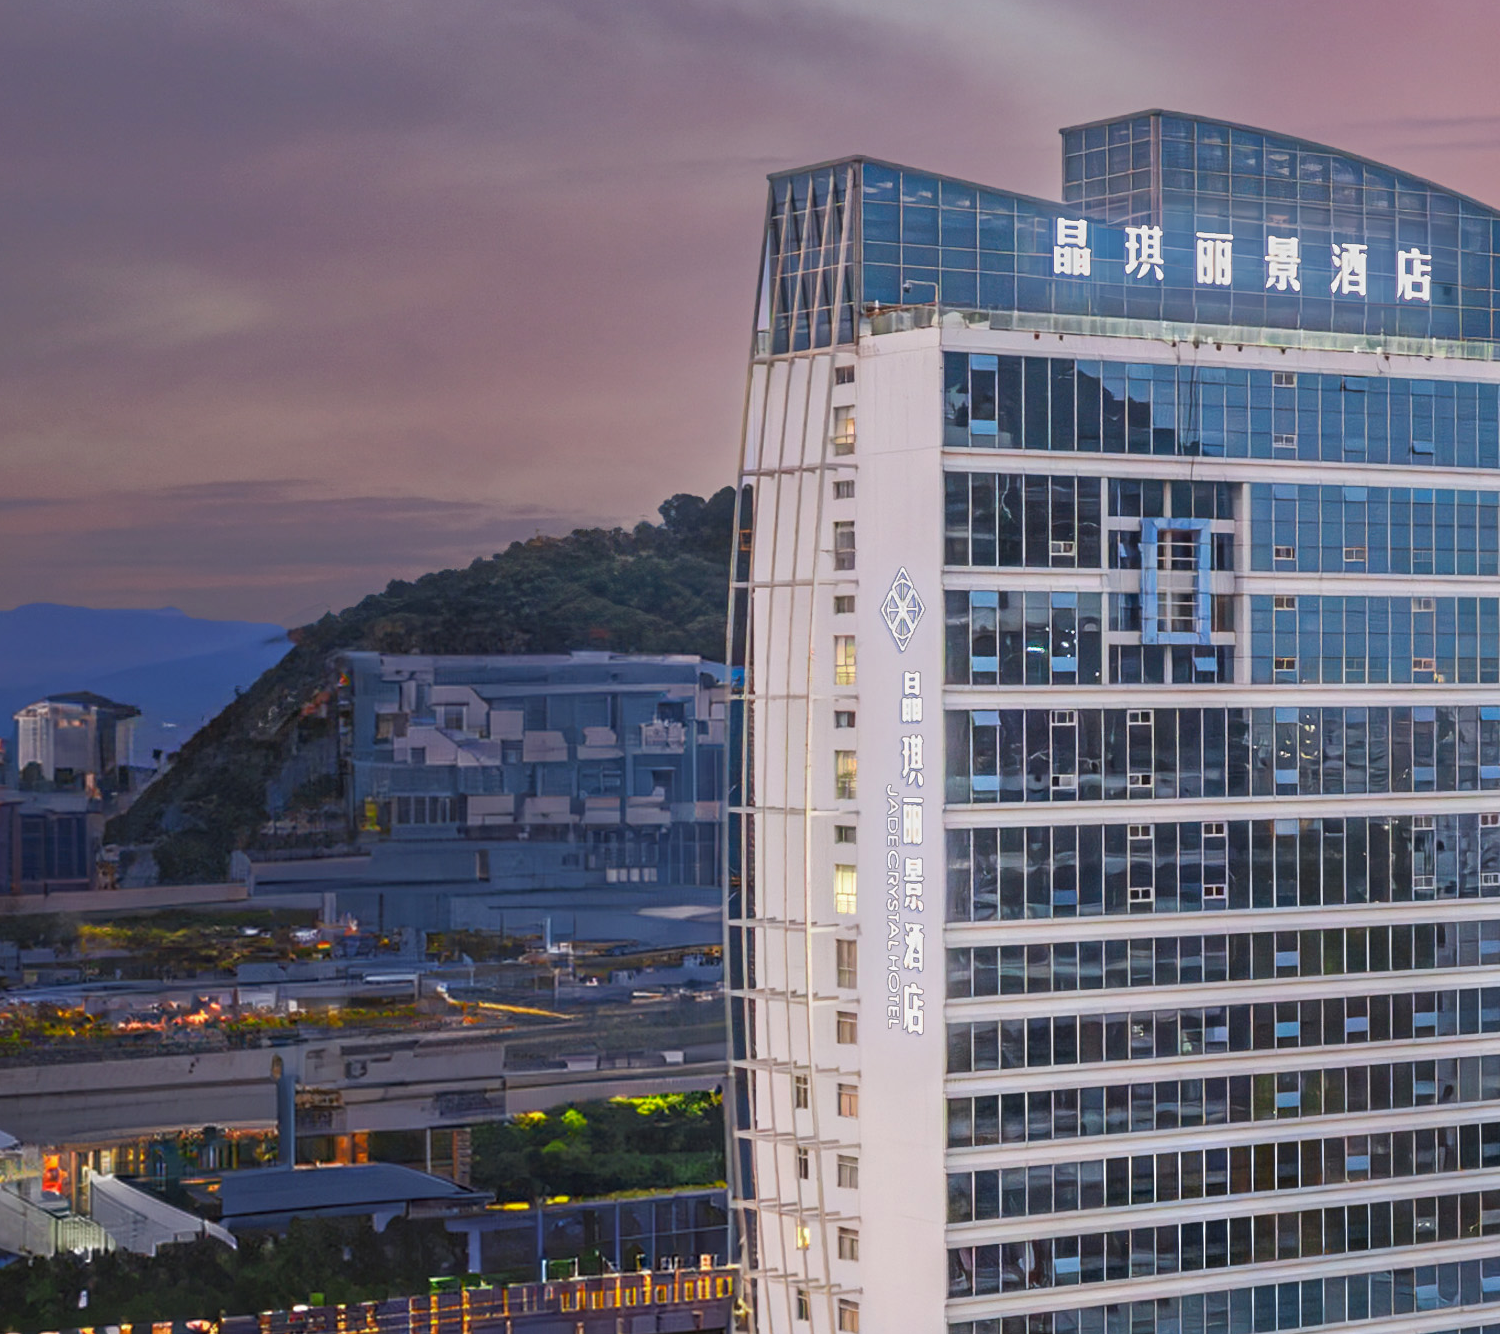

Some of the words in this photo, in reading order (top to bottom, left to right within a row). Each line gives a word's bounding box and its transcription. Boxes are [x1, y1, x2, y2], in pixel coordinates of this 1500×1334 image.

[1053, 217, 1432, 302] 晶琪丽景酒店
[886, 783, 900, 847] JADE
[900, 670, 925, 1035] 晶琪丽景酒店
[886, 849, 900, 951] CRYSTAL
[886, 954, 901, 1030] HOTEL
